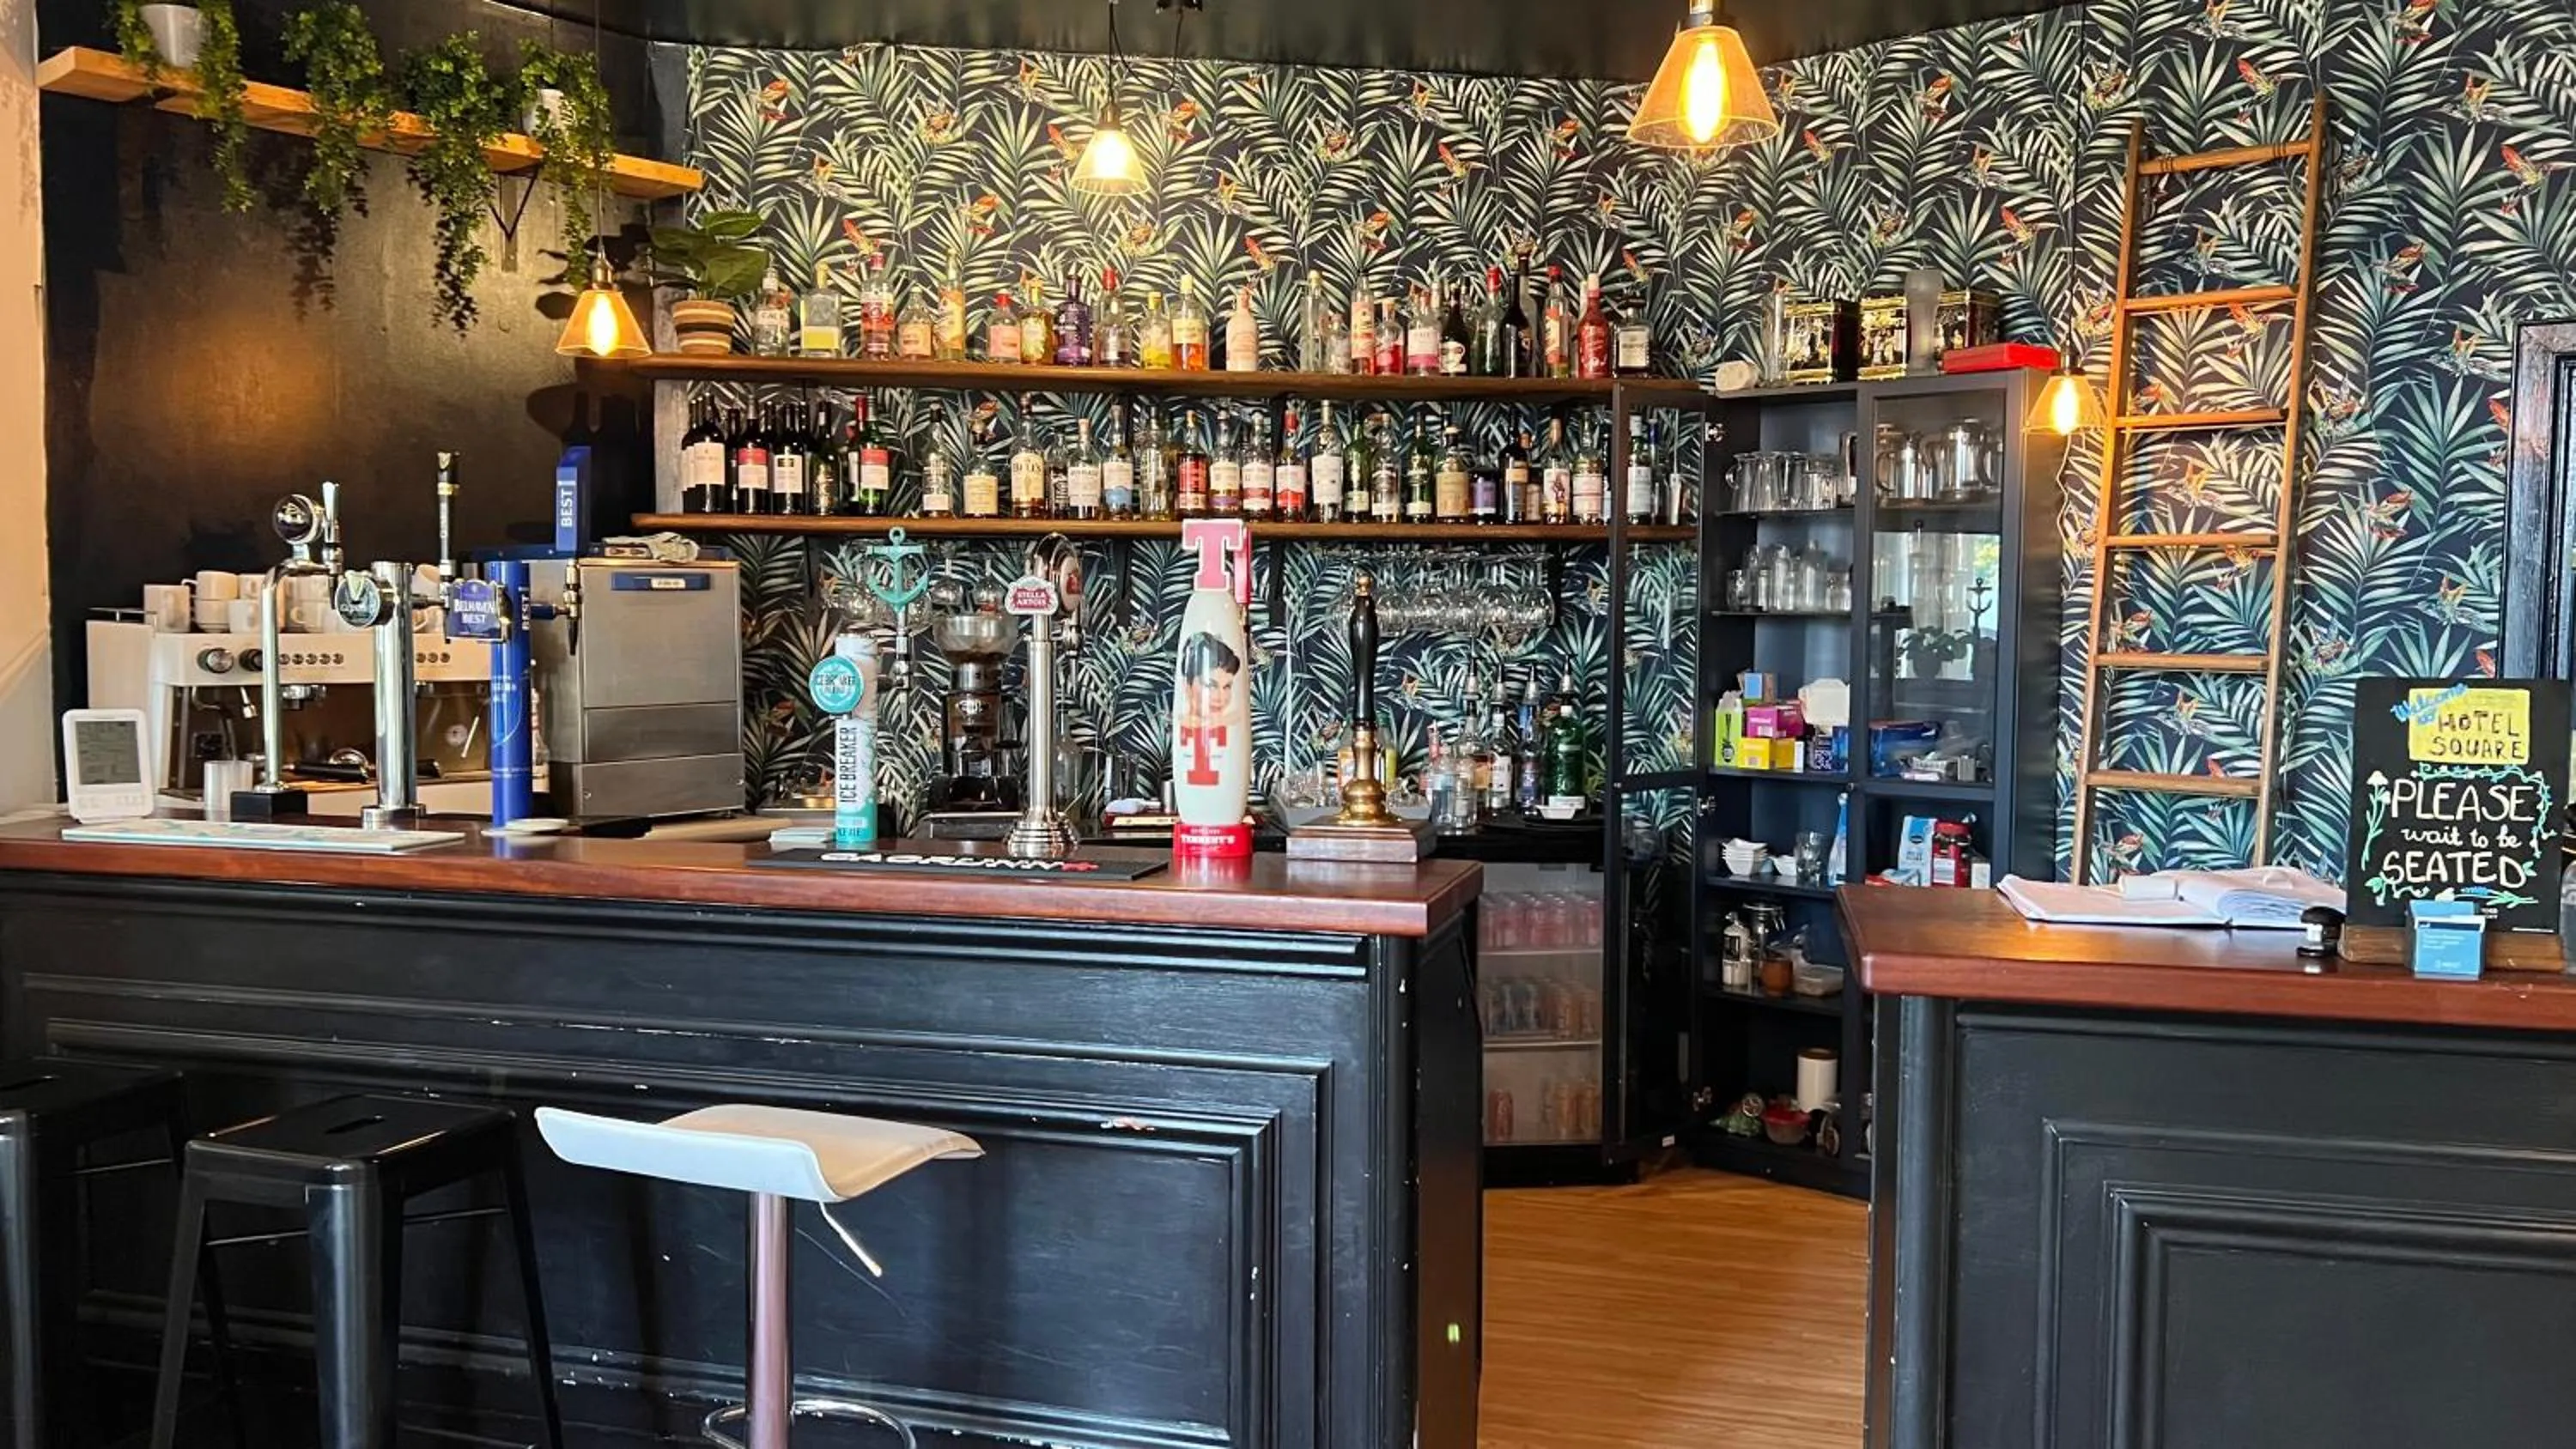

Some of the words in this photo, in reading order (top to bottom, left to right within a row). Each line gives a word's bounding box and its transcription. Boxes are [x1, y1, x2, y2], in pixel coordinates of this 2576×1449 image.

[561, 487, 573, 528] BEST
[453, 598, 495, 614] BELHAVEN
[462, 614, 486, 624] BEST
[2438, 710, 2520, 737] HOTEL
[2430, 736, 2525, 760] SQUARE
[2391, 779, 2535, 822] PLEASE
[2401, 825, 2464, 846] wait
[2470, 828, 2488, 848] to
[2497, 824, 2522, 848] be
[2382, 851, 2526, 888] SEATED
